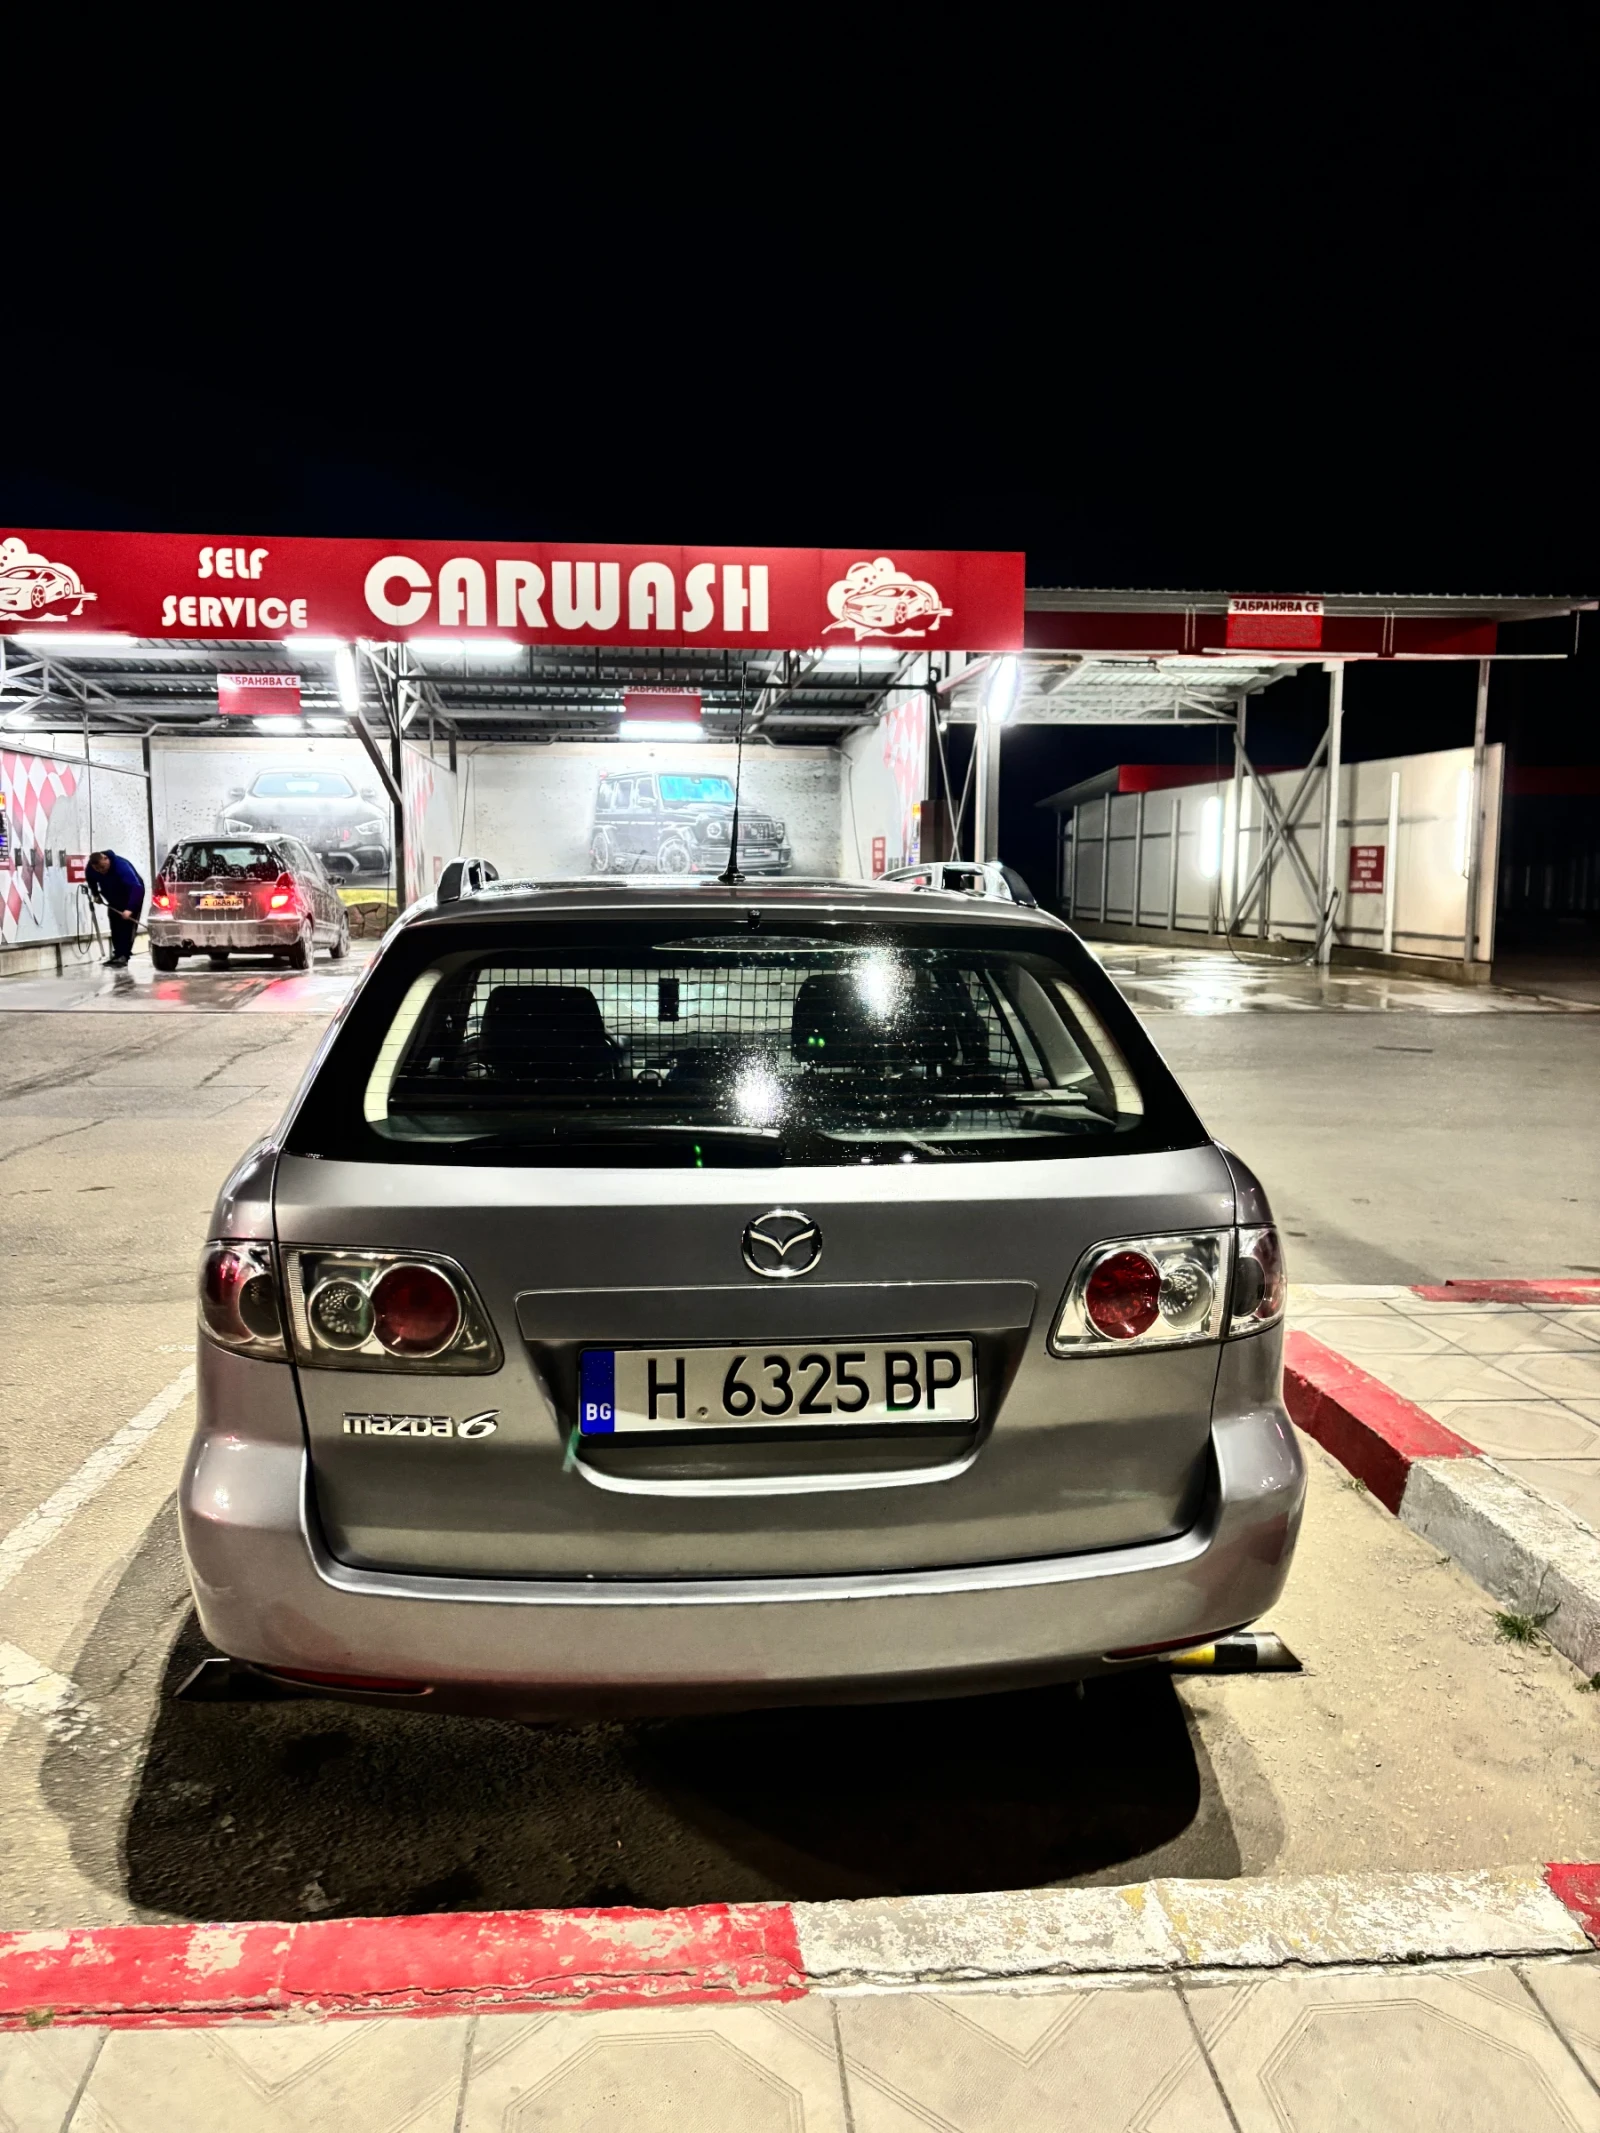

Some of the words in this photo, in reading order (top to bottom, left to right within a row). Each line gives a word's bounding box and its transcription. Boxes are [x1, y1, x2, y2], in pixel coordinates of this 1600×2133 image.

[198, 547, 269, 579] SELF
[364, 555, 769, 632] CARWASH
[1233, 600, 1302, 612] ЗАБРАНЯВА
[1305, 602, 1320, 612] СЕ
[161, 595, 308, 629] SERVICE
[225, 676, 282, 686] БРАНЯВА
[285, 677, 297, 686] СЕ
[647, 1357, 686, 1420] H
[721, 1352, 870, 1417] 6325
[885, 1350, 962, 1412] BP
[585, 1403, 612, 1421] BG
